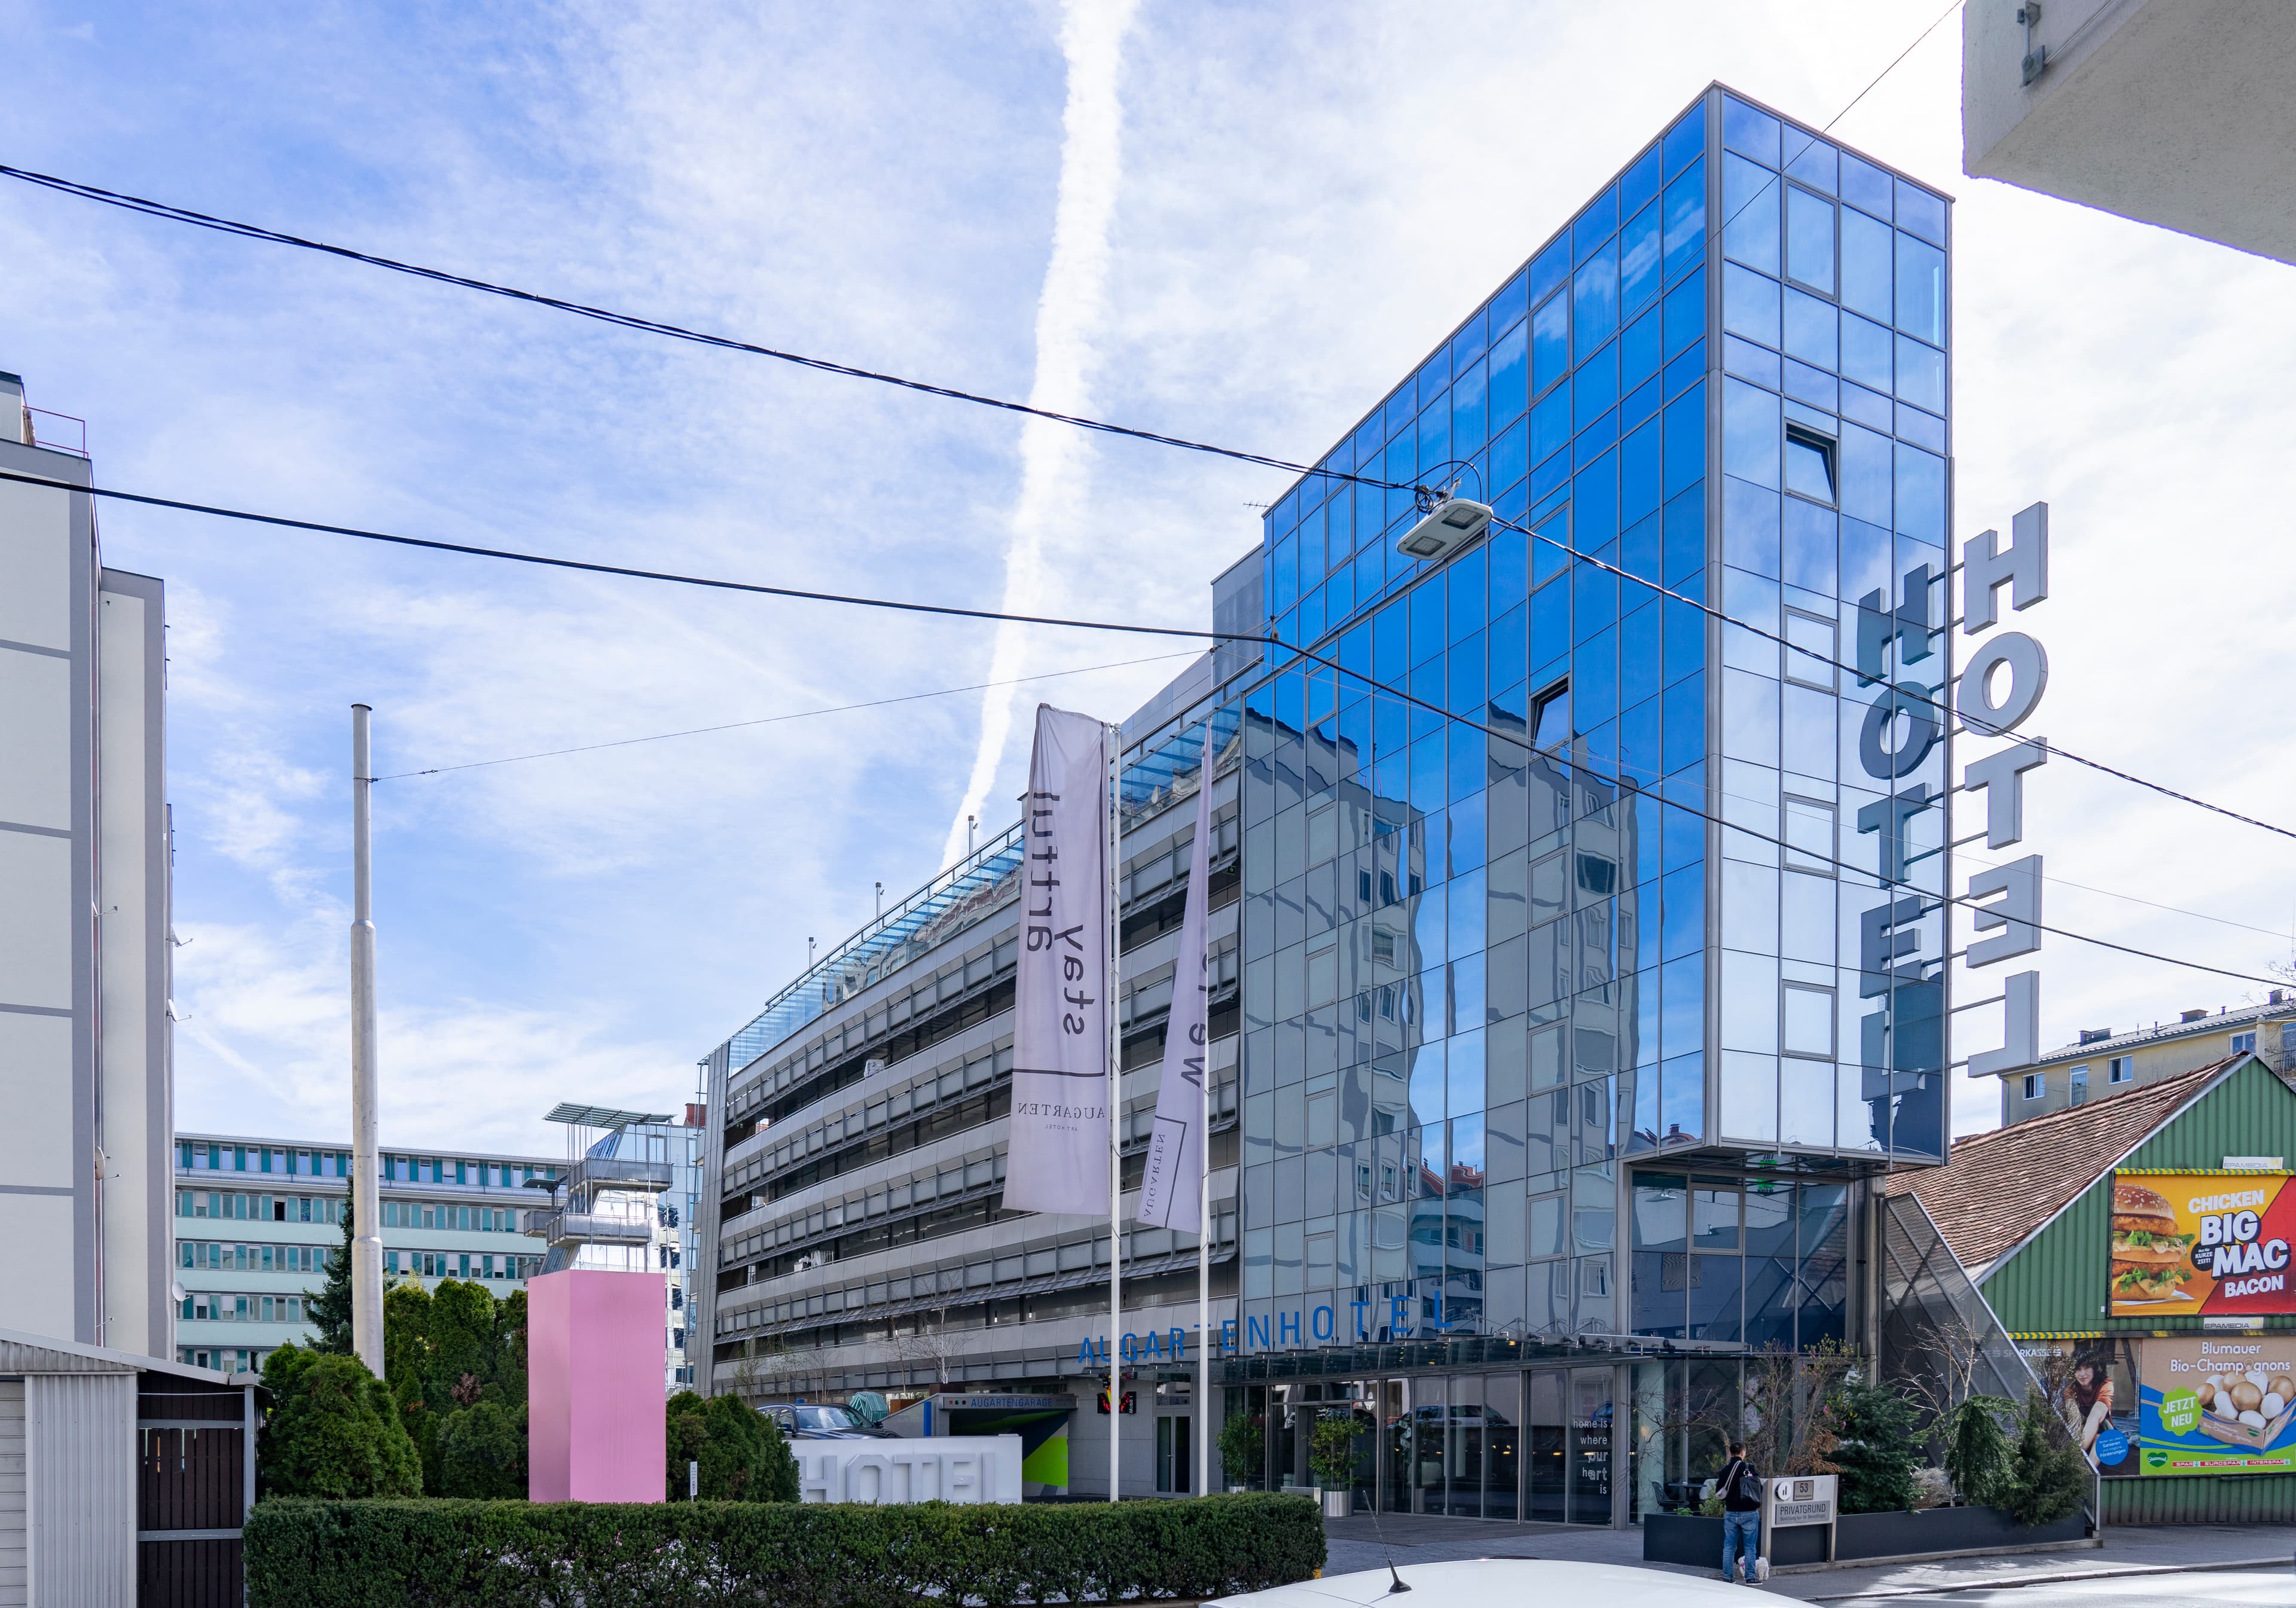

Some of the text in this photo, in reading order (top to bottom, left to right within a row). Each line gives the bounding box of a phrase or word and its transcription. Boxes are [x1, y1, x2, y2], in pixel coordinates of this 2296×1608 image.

[2188, 1189, 2264, 1213] CHICKEN
[2200, 1209, 2260, 1246] BIG
[2212, 1238, 2289, 1277] MAC
[2224, 1274, 2284, 1298] BACON
[2202, 1341, 2261, 1354] Blumauer
[970, 1398, 1052, 1407] AUGARTENGARAGE
[2163, 1396, 2196, 1414] JETZT
[1573, 1418, 1608, 1428] home is
[2171, 1412, 2193, 1428] NEU
[1580, 1435, 1608, 1445] where
[793, 1453, 1018, 1503] HOTEL
[1599, 1484, 1607, 1494] is
[1800, 1483, 1809, 1493] 53
[1780, 1503, 1826, 1515] PRIVATGRUND
